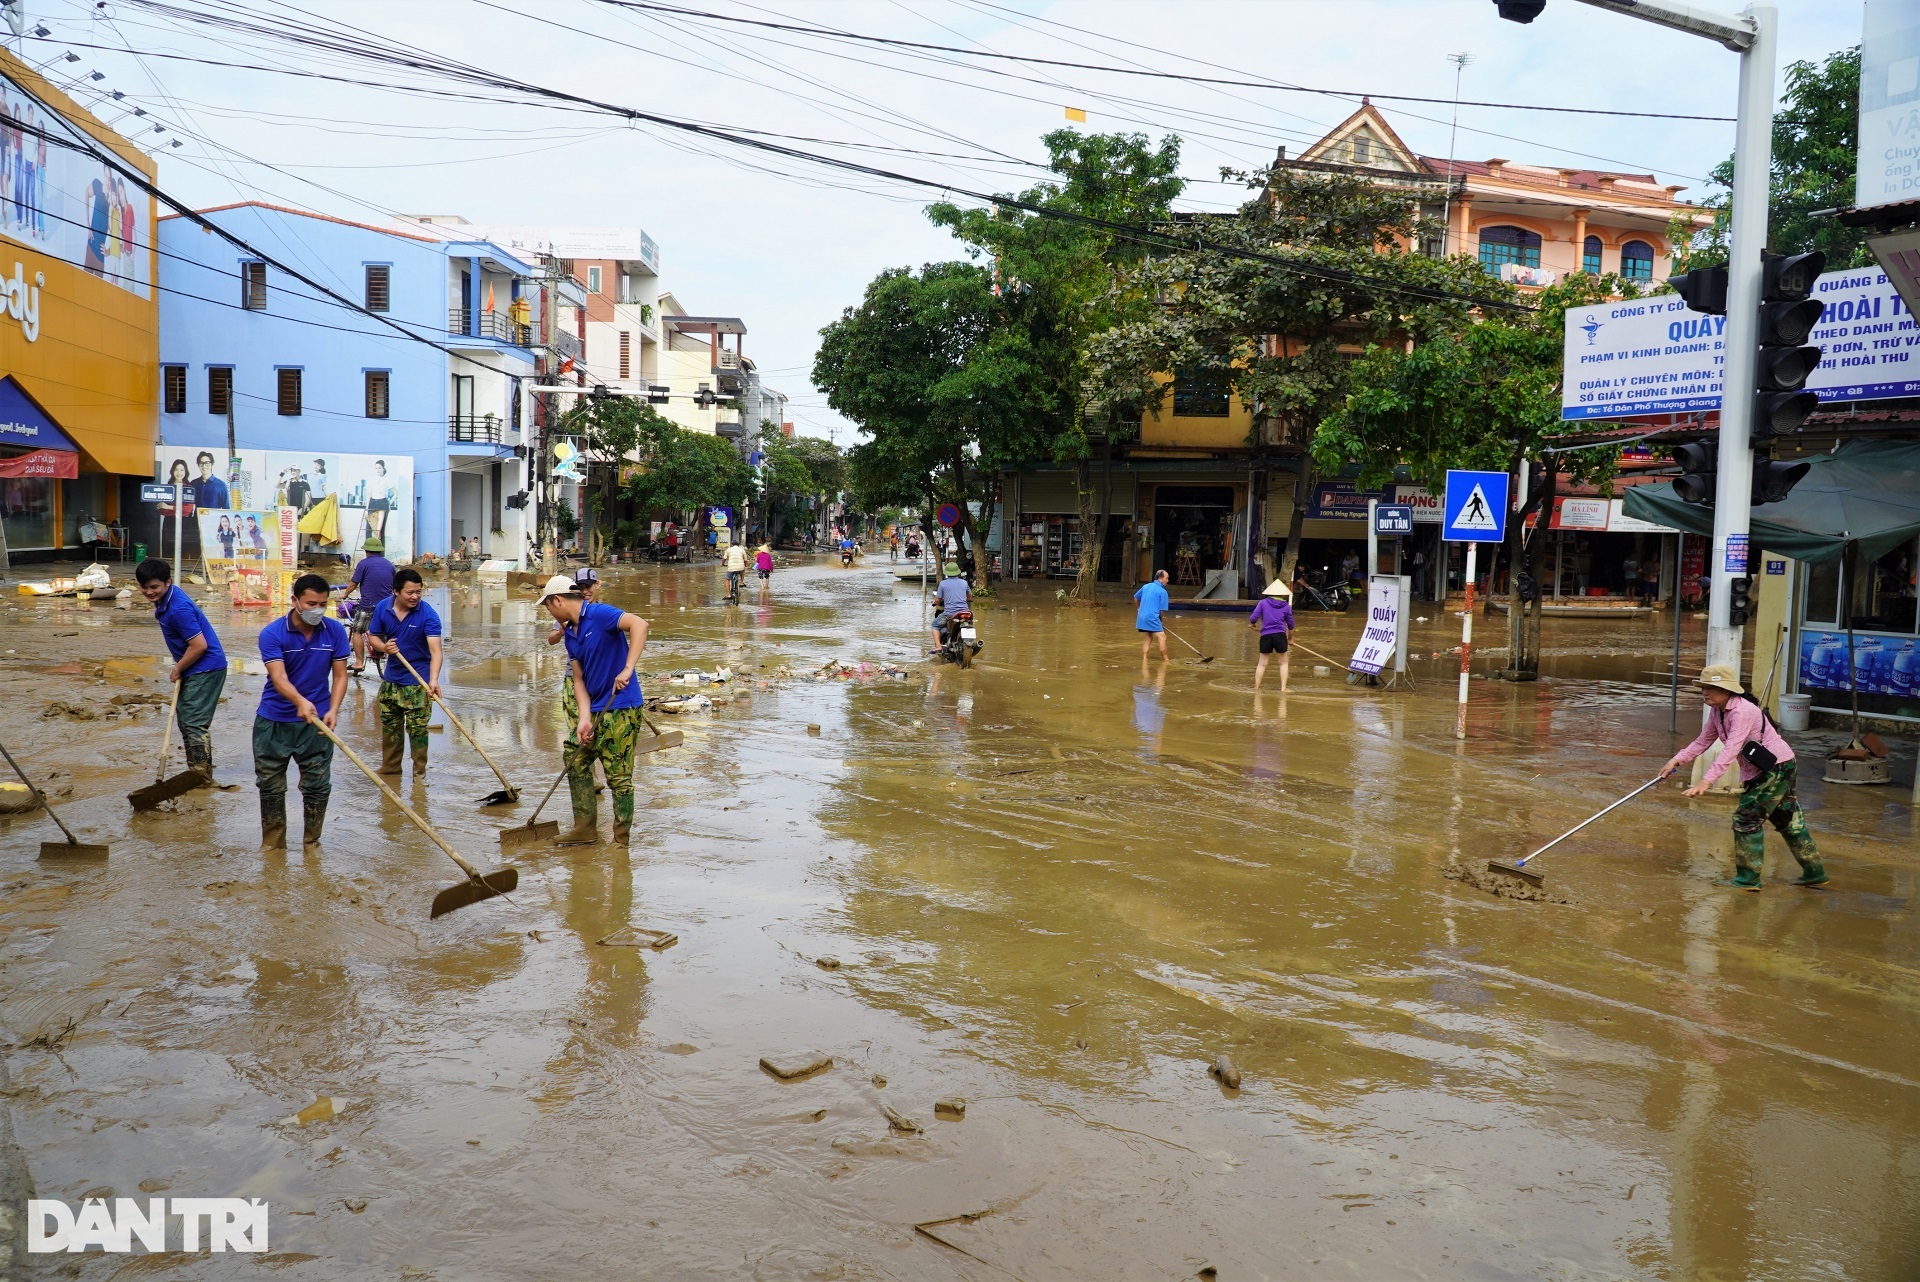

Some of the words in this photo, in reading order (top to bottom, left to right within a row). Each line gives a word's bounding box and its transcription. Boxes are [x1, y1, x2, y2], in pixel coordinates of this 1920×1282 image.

[1885, 162, 1911, 177] ống
[1611, 307, 1645, 319] CÔNG
[1650, 304, 1663, 314] TY
[1819, 276, 1871, 292] QUẢNG
[1877, 274, 1891, 285] B
[1820, 294, 1881, 324] HOÀI
[1890, 294, 1911, 316] T
[1581, 352, 1614, 364] PHẠM
[1618, 351, 1629, 360] VI
[1632, 346, 1661, 358] KINH
[1664, 343, 1710, 355] DOANH:
[1813, 327, 1848, 340] THEO
[1853, 322, 1893, 336] DANH
[1832, 342, 1867, 354] ĐƠN,
[1872, 336, 1902, 350] TRỪ
[1580, 378, 1610, 390] QUẢN
[1613, 377, 1627, 387] LÝ
[1631, 371, 1678, 386] CHUYÊN
[1682, 369, 1715, 381] MÔN:
[1841, 354, 1876, 368] HOÀI
[1881, 352, 1909, 364] THU
[1580, 391, 1594, 402] SỐ
[1597, 388, 1623, 401] GIẤY
[1627, 388, 1667, 399] CHỨNG
[1671, 384, 1706, 396] NHẬN
[1586, 405, 1601, 414] Đc:
[1603, 403, 1614, 413] Tổ
[1615, 402, 1632, 412] Dân
[1634, 401, 1651, 410] Phố
[1652, 399, 1686, 410] Thượng
[1688, 399, 1717, 407] Giang
[1847, 387, 1863, 396] QB
[281, 509, 292, 530] SHOP
[1380, 518, 1393, 529] DUY
[1394, 517, 1408, 530] TÂN
[281, 532, 292, 547] HOA
[281, 548, 293, 566] TƯƠI
[1771, 561, 1781, 569] 01
[1365, 626, 1394, 643] THUỐC
[1361, 646, 1380, 661] TÂY
